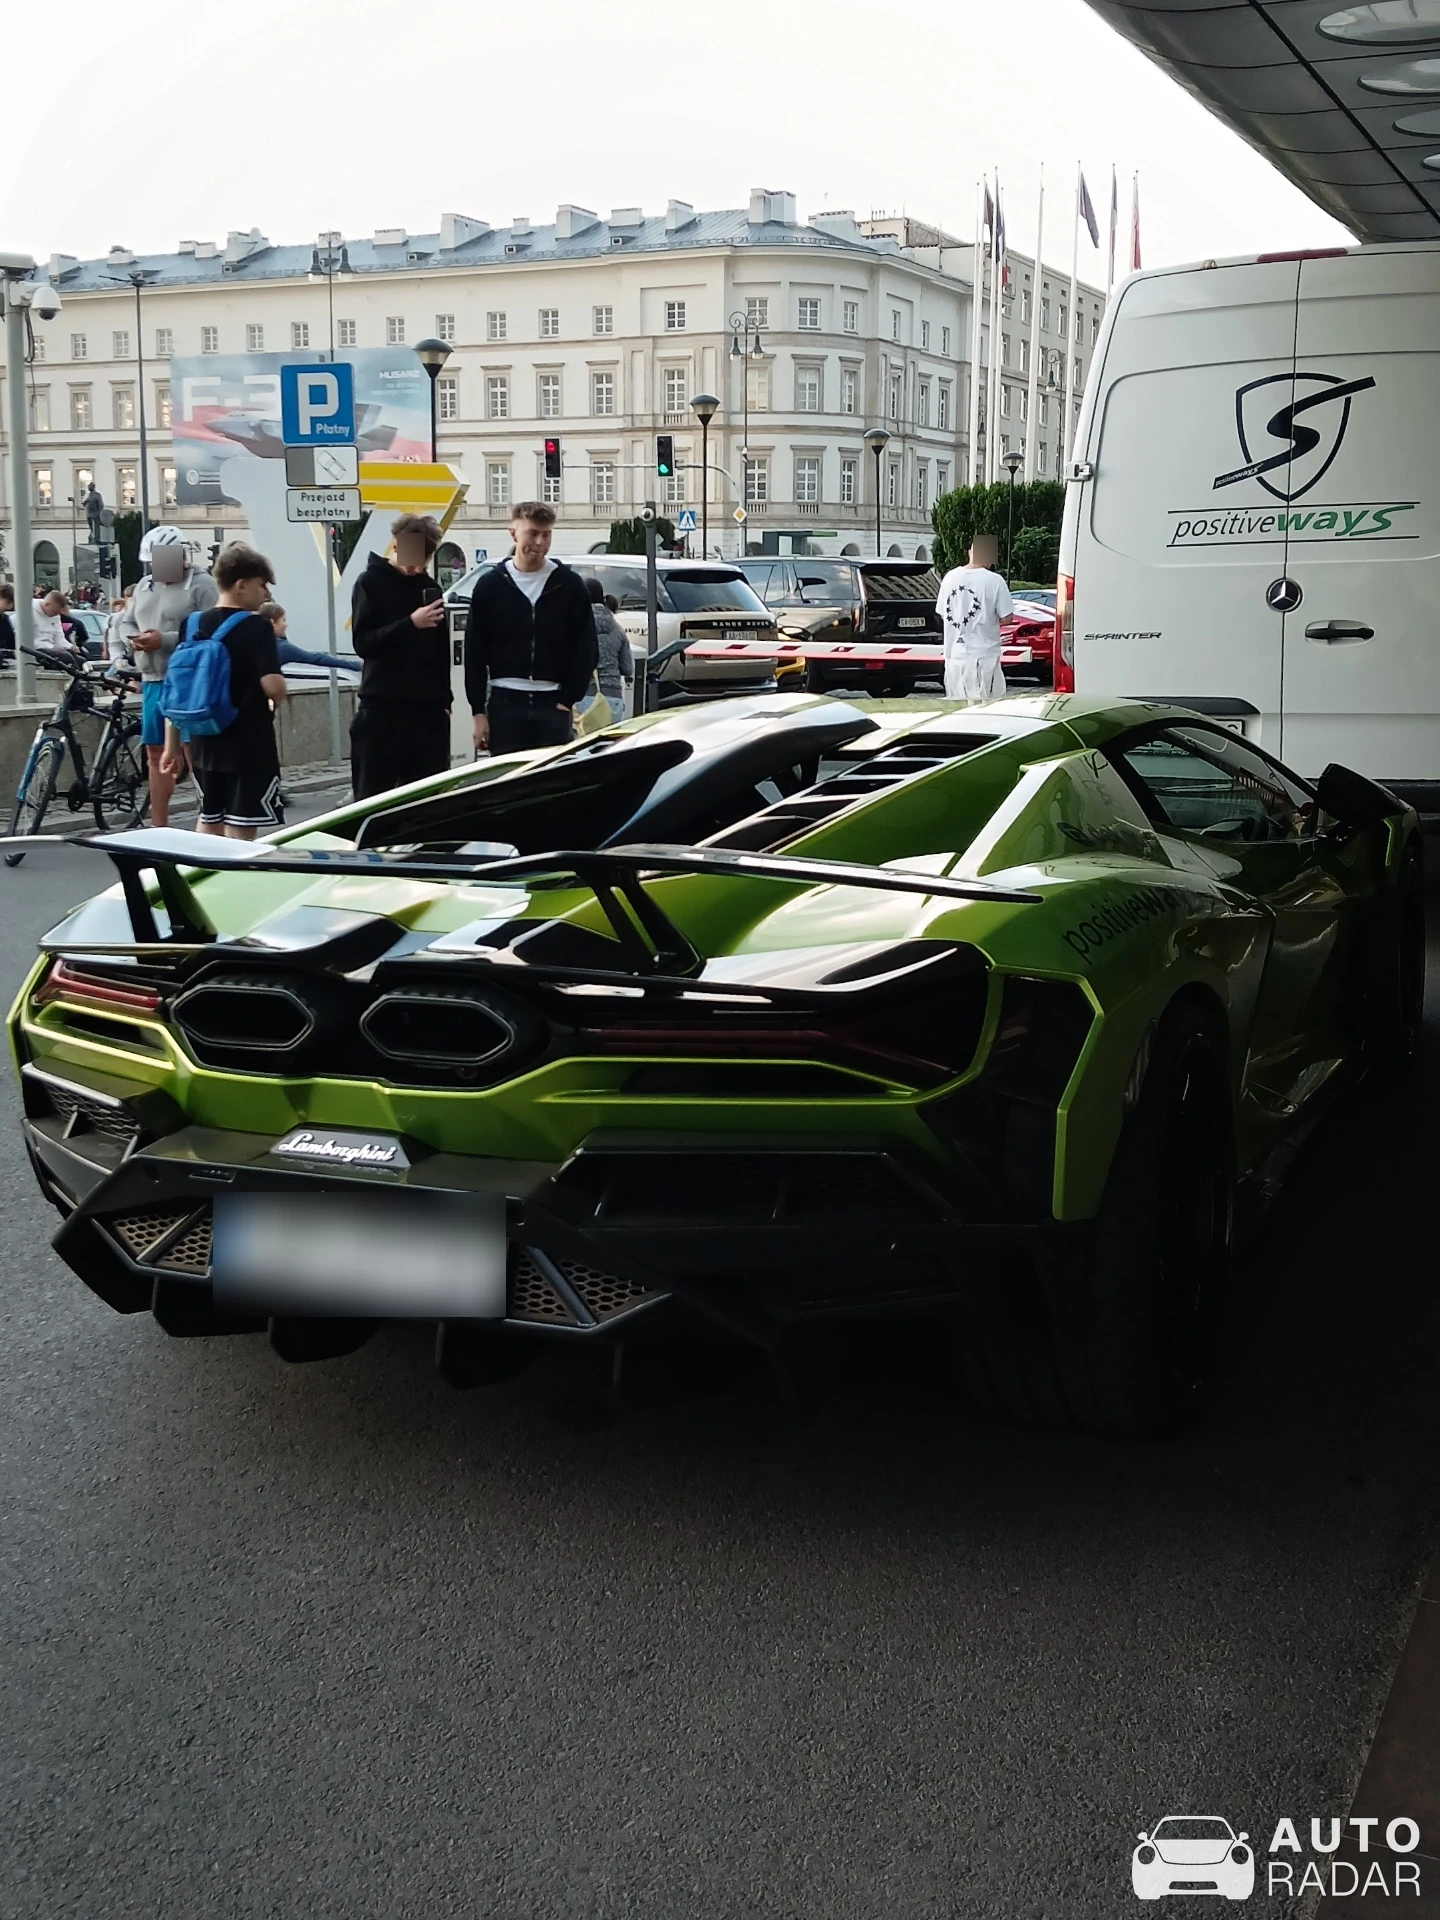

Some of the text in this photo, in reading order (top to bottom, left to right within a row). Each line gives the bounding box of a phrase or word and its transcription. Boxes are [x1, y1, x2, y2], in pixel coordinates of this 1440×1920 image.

[182, 374, 281, 422] F-3
[296, 372, 340, 435] P
[315, 423, 351, 437] Płatny
[300, 492, 346, 504] Przejazd
[296, 507, 352, 518] bezpłatny
[1171, 504, 1415, 544] positiveways
[1083, 631, 1162, 641] SPRINTER
[277, 1132, 396, 1163] Lamborghini
